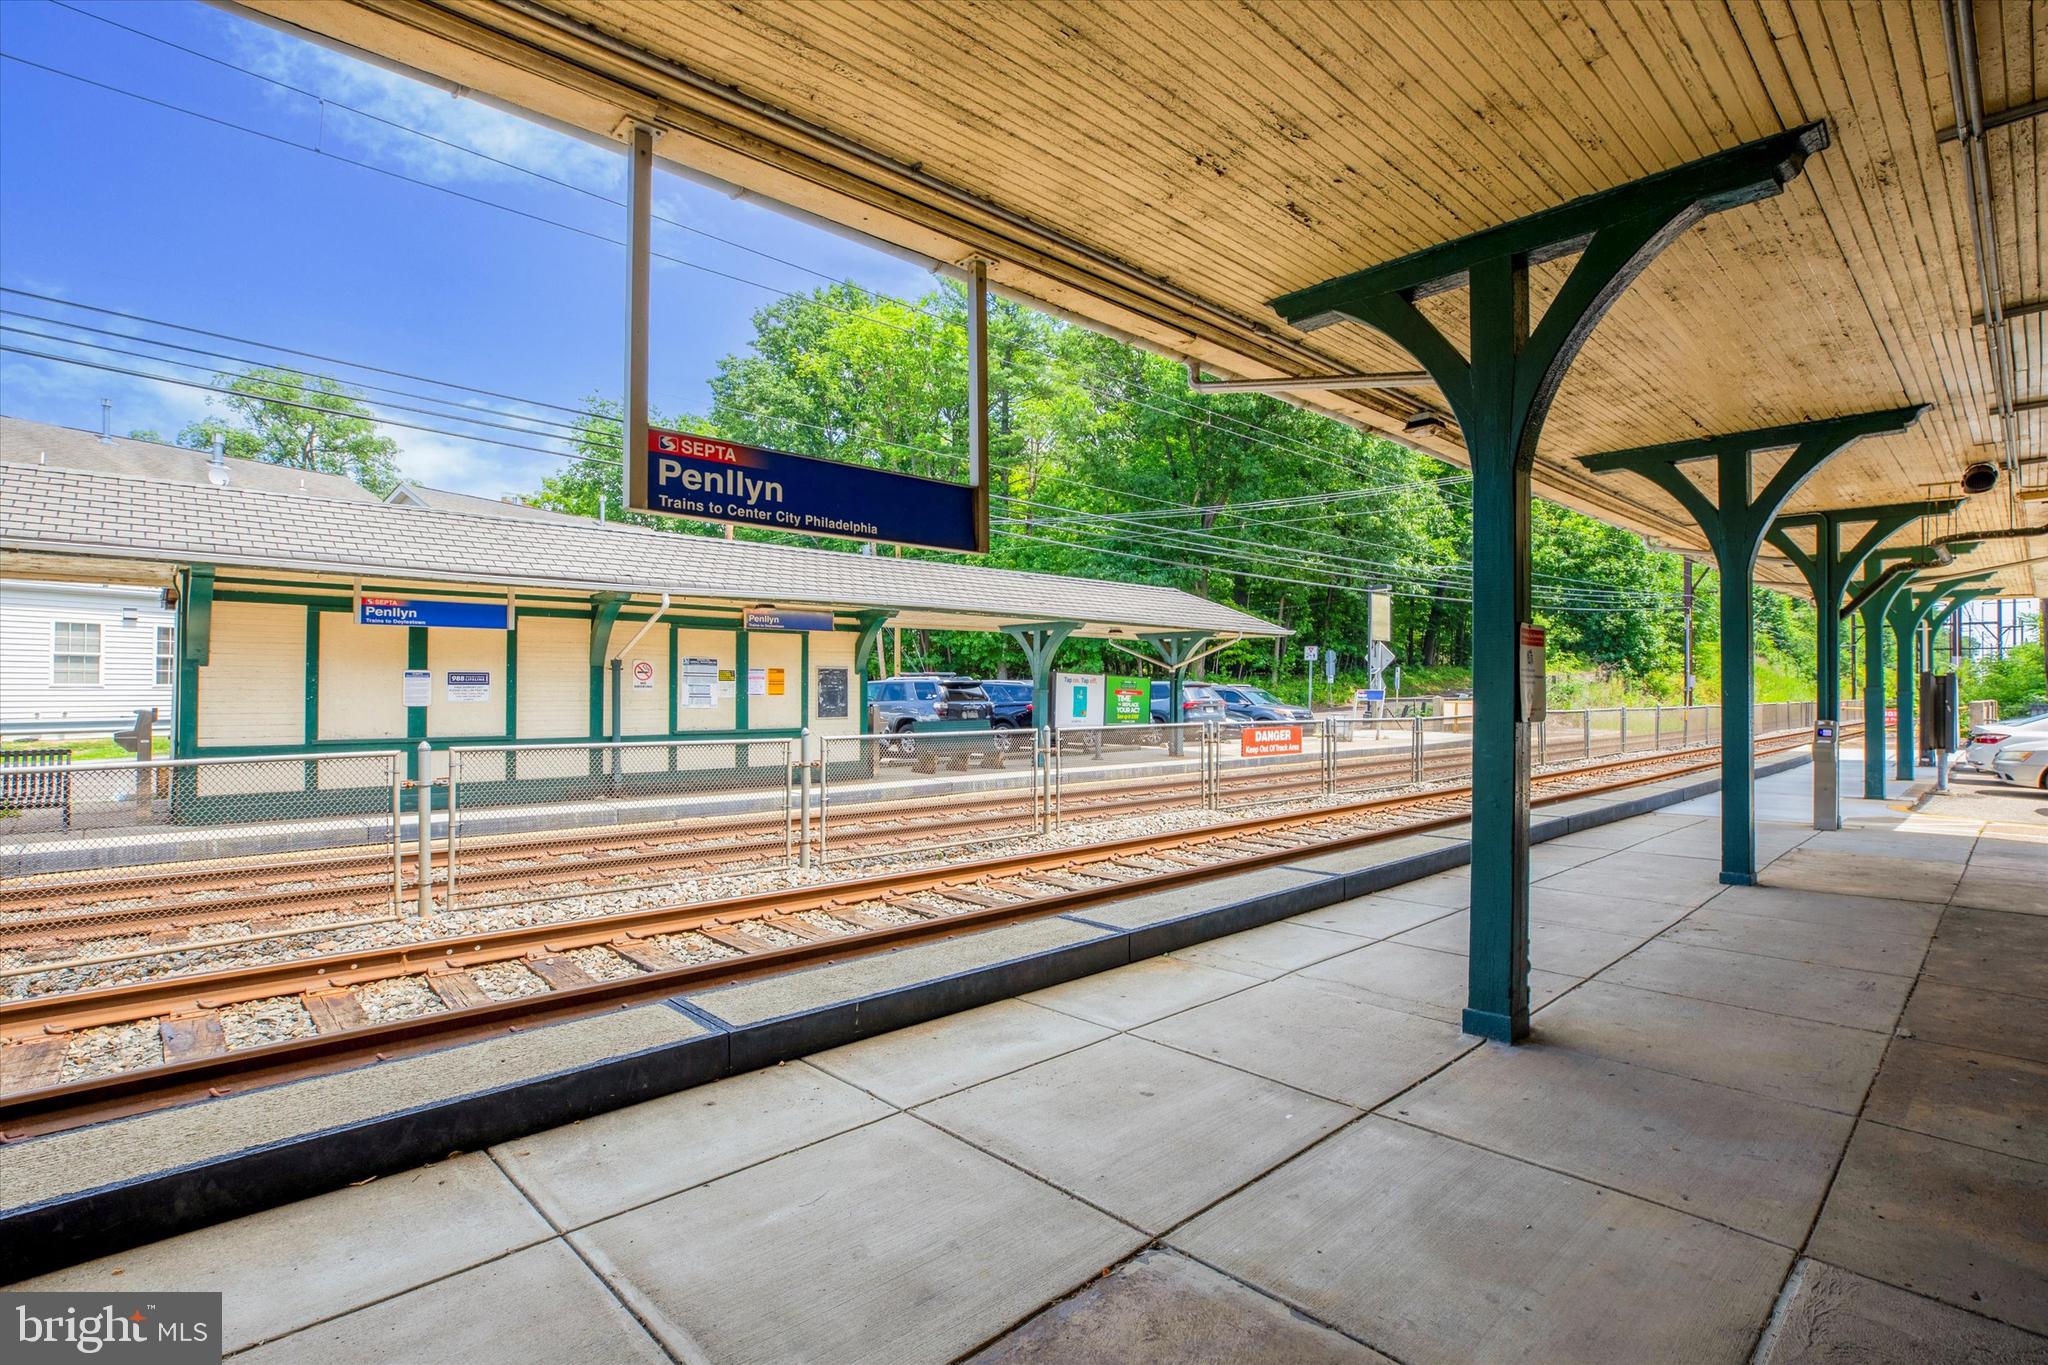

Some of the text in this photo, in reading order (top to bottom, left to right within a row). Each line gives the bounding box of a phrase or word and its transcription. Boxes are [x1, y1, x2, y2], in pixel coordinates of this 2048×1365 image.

[681, 440, 736, 462] SEPTA
[658, 458, 783, 505] Penllyn
[658, 494, 878, 534] Trains to Center City Philadelphia
[366, 606, 417, 620] Penllyn
[748, 614, 780, 624] Penllyn
[1255, 730, 1291, 742] DANGER
[1245, 745, 1259, 754] Keep
[1260, 745, 1269, 753] Out
